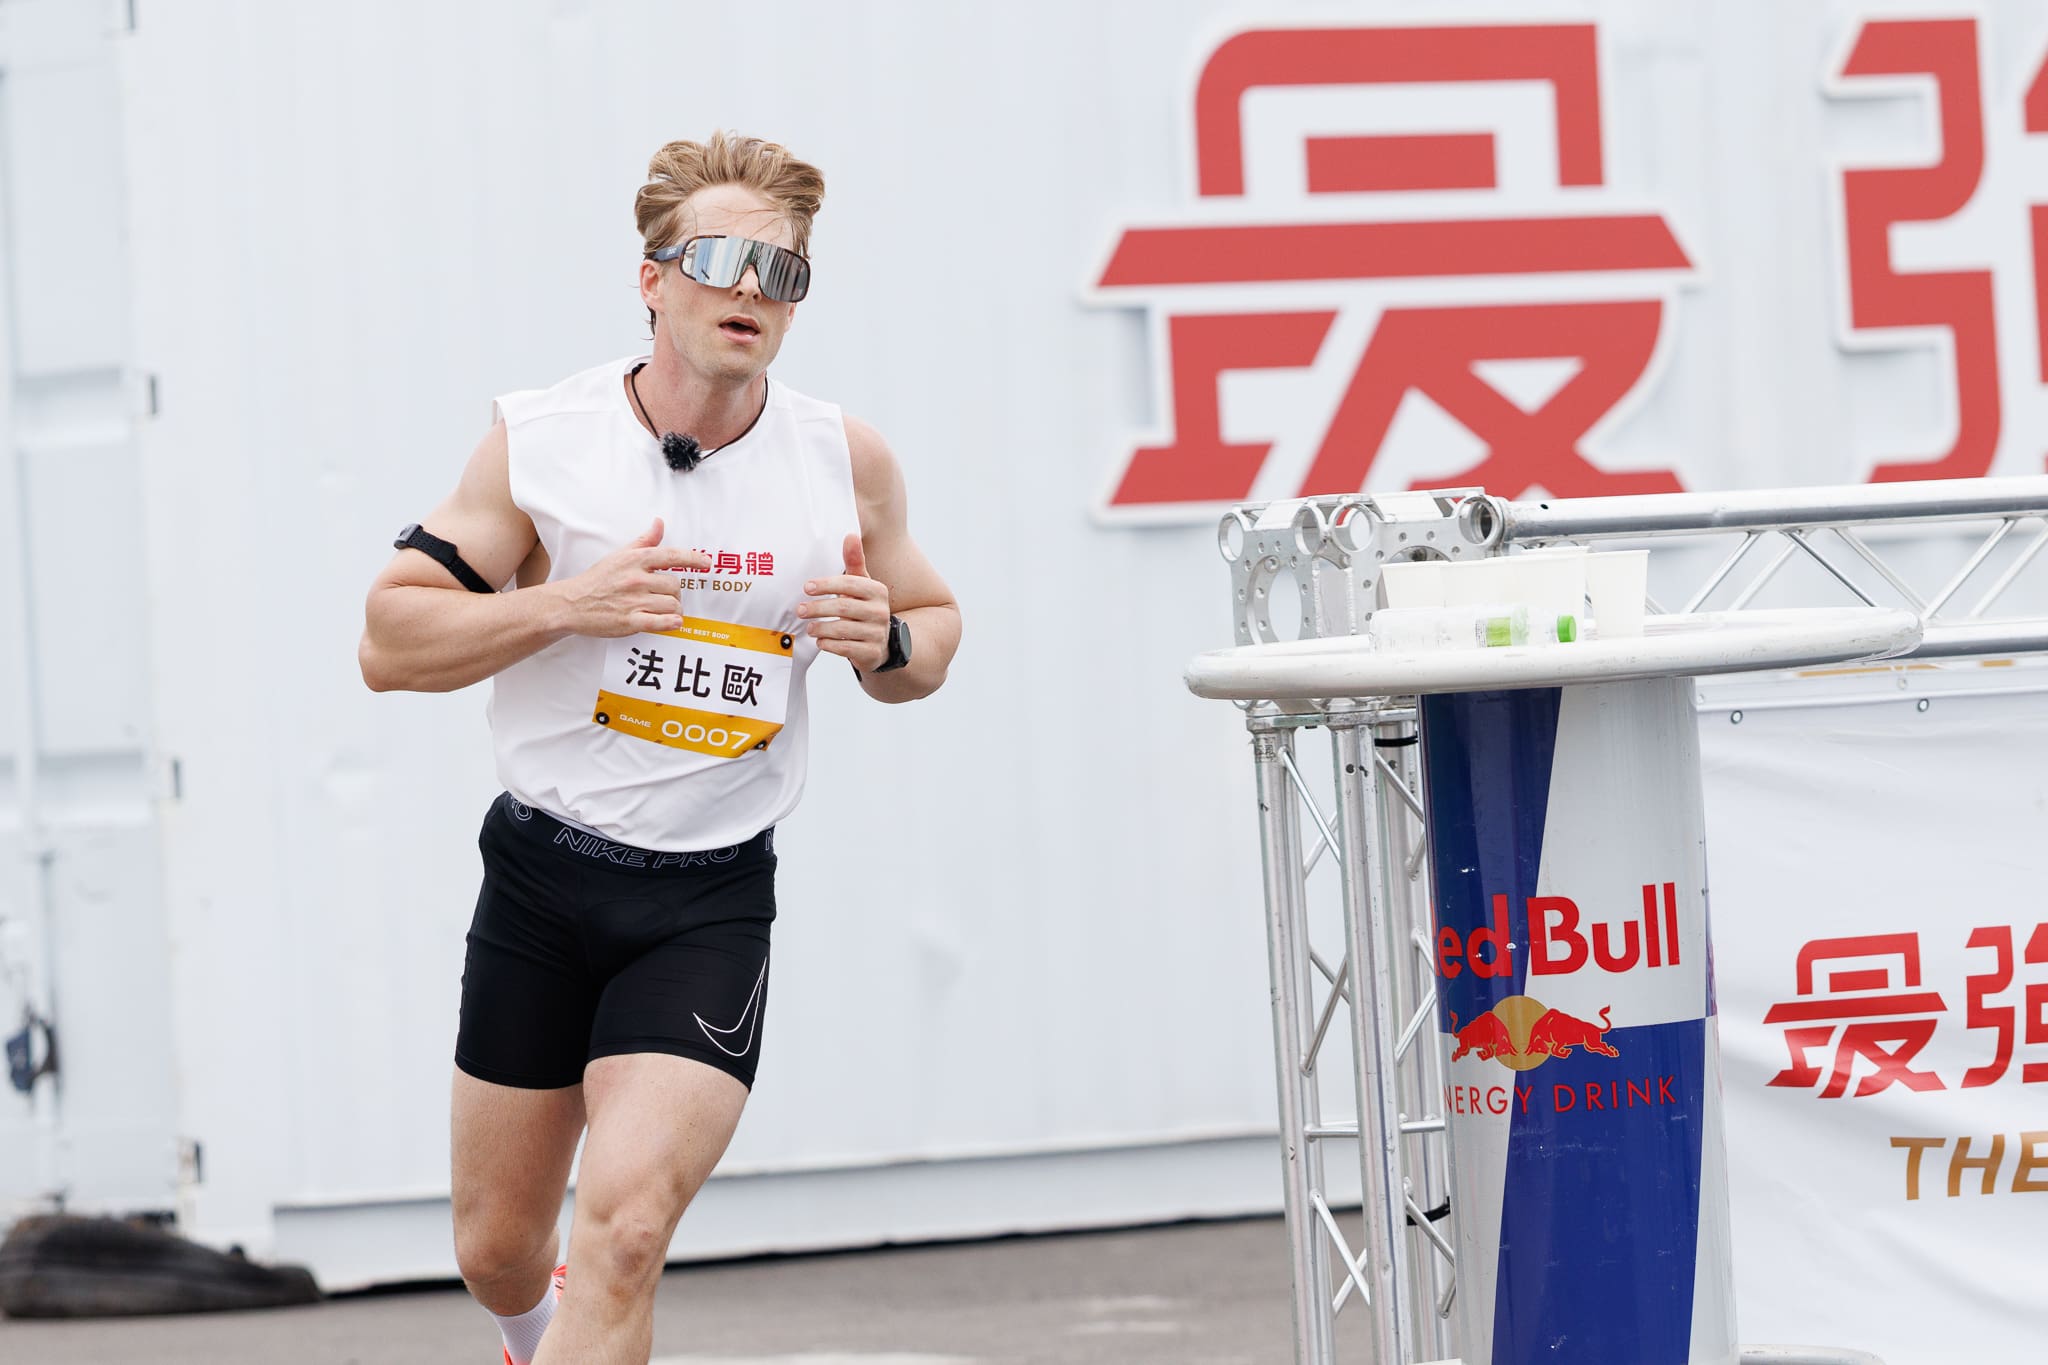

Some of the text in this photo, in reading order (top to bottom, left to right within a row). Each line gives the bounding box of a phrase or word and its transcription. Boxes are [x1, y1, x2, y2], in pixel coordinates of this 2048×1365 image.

[681, 578, 752, 592] BET BODY
[693, 629, 710, 637] BEST
[712, 632, 730, 640] BODY
[625, 647, 763, 706] 法比歐
[619, 713, 751, 750] GAME 0007
[554, 827, 652, 867] NIKE
[653, 845, 738, 868] PRO
[1431, 882, 1680, 979] ed Bull
[1554, 1075, 1676, 1113] DRINK
[1890, 1131, 2048, 1200] THE
